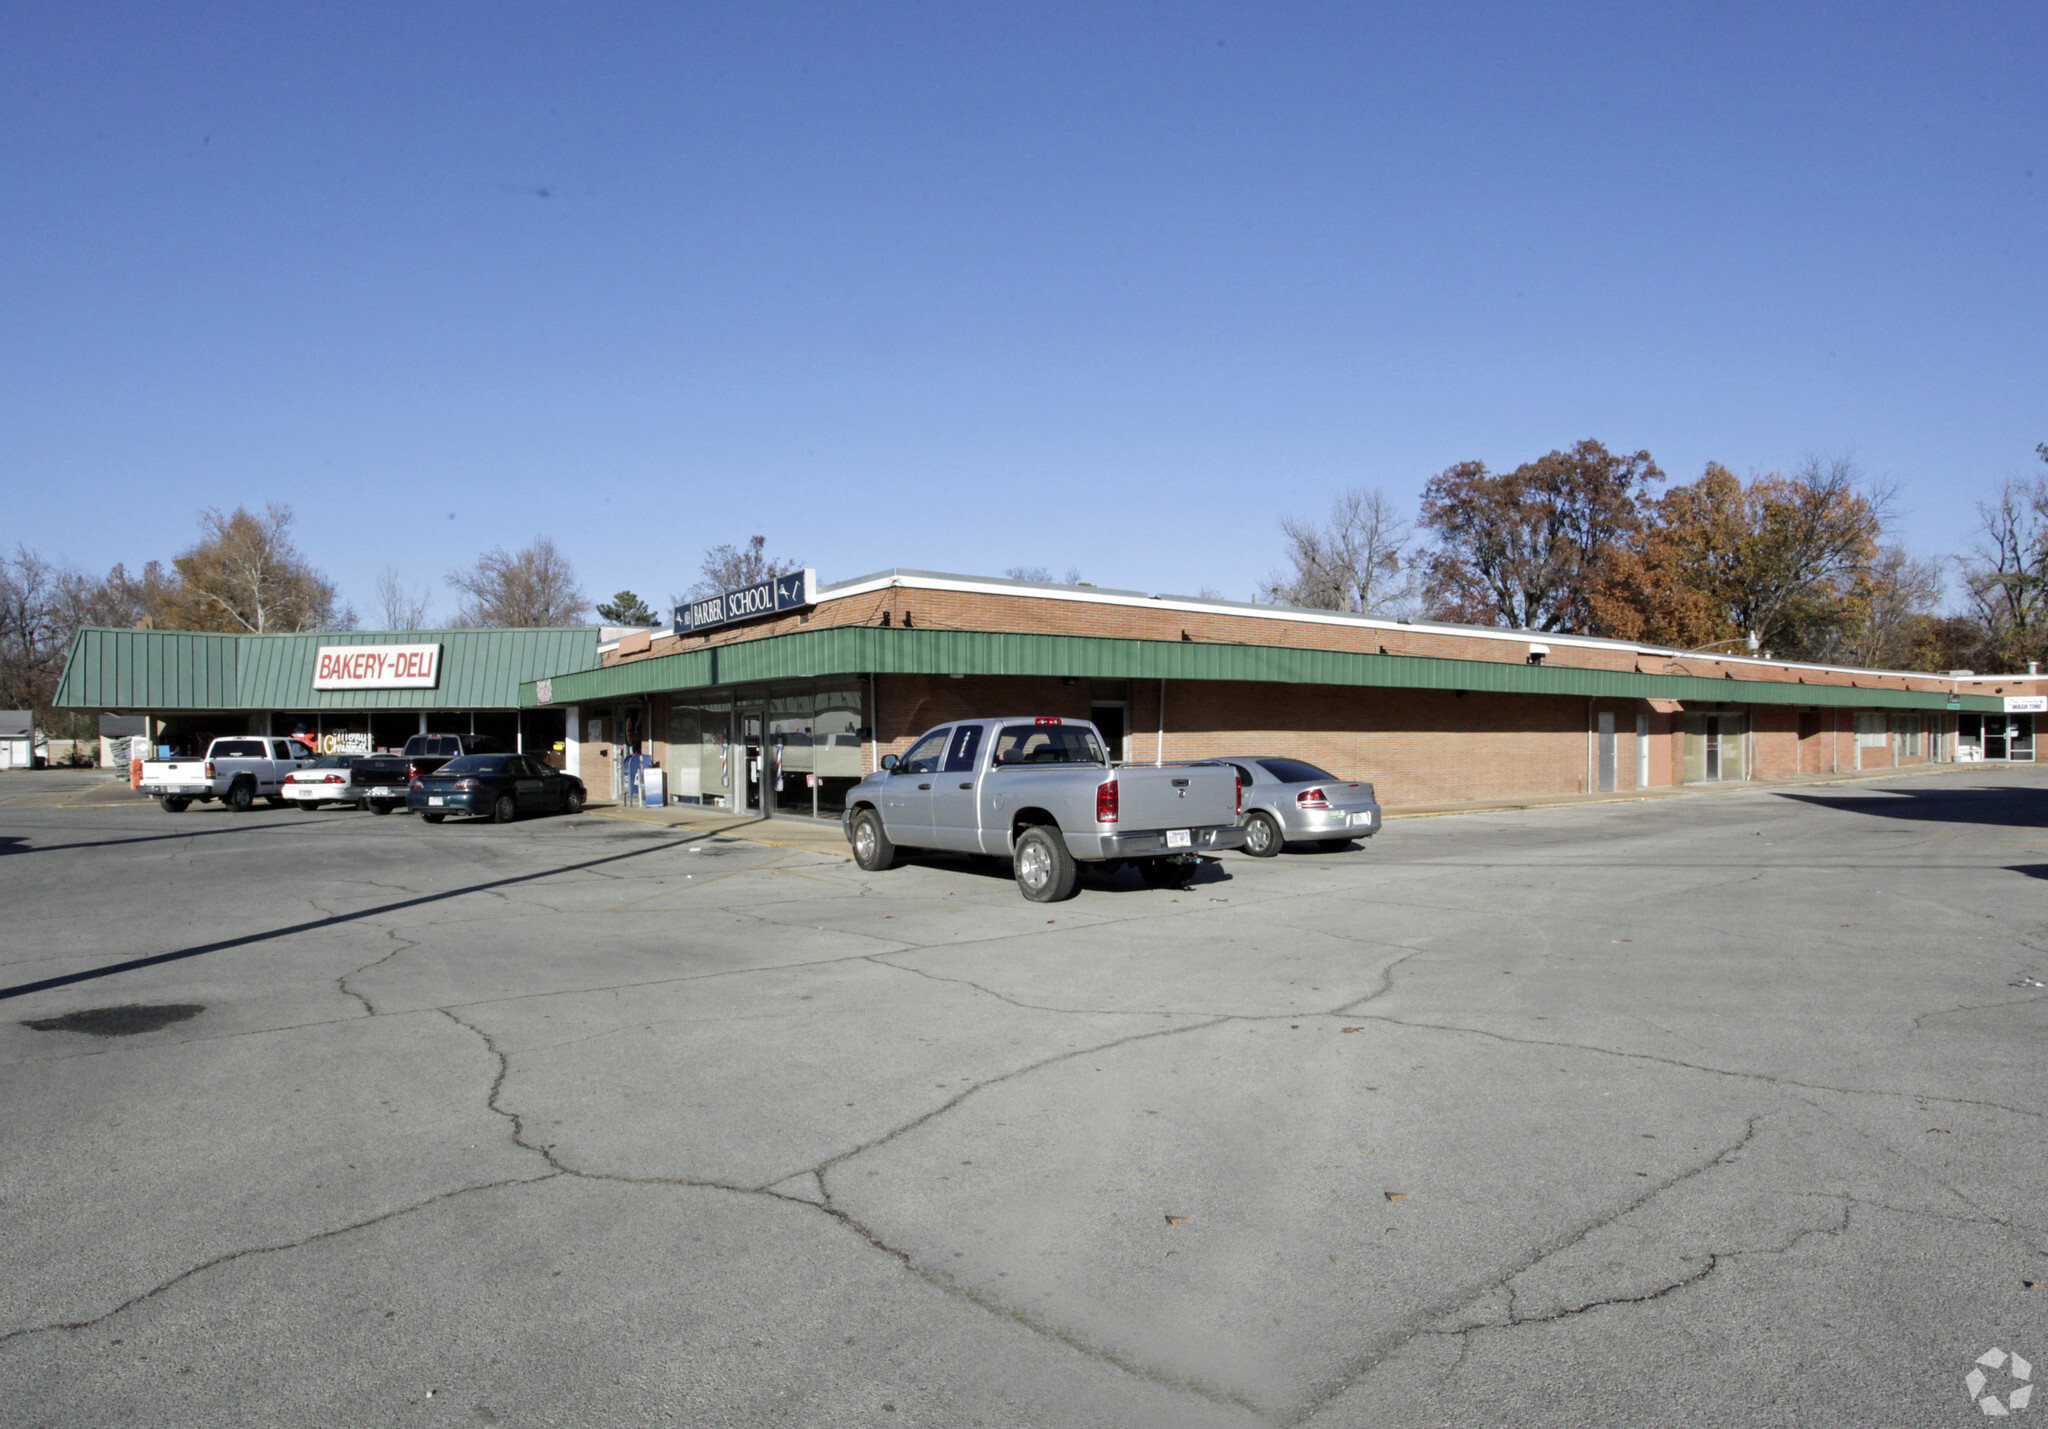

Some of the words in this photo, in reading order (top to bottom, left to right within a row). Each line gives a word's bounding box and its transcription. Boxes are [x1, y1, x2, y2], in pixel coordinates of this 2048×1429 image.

[693, 599, 723, 626] BARBER
[729, 586, 773, 617] SCHOOL
[319, 652, 434, 680] BAKERY-DELI
